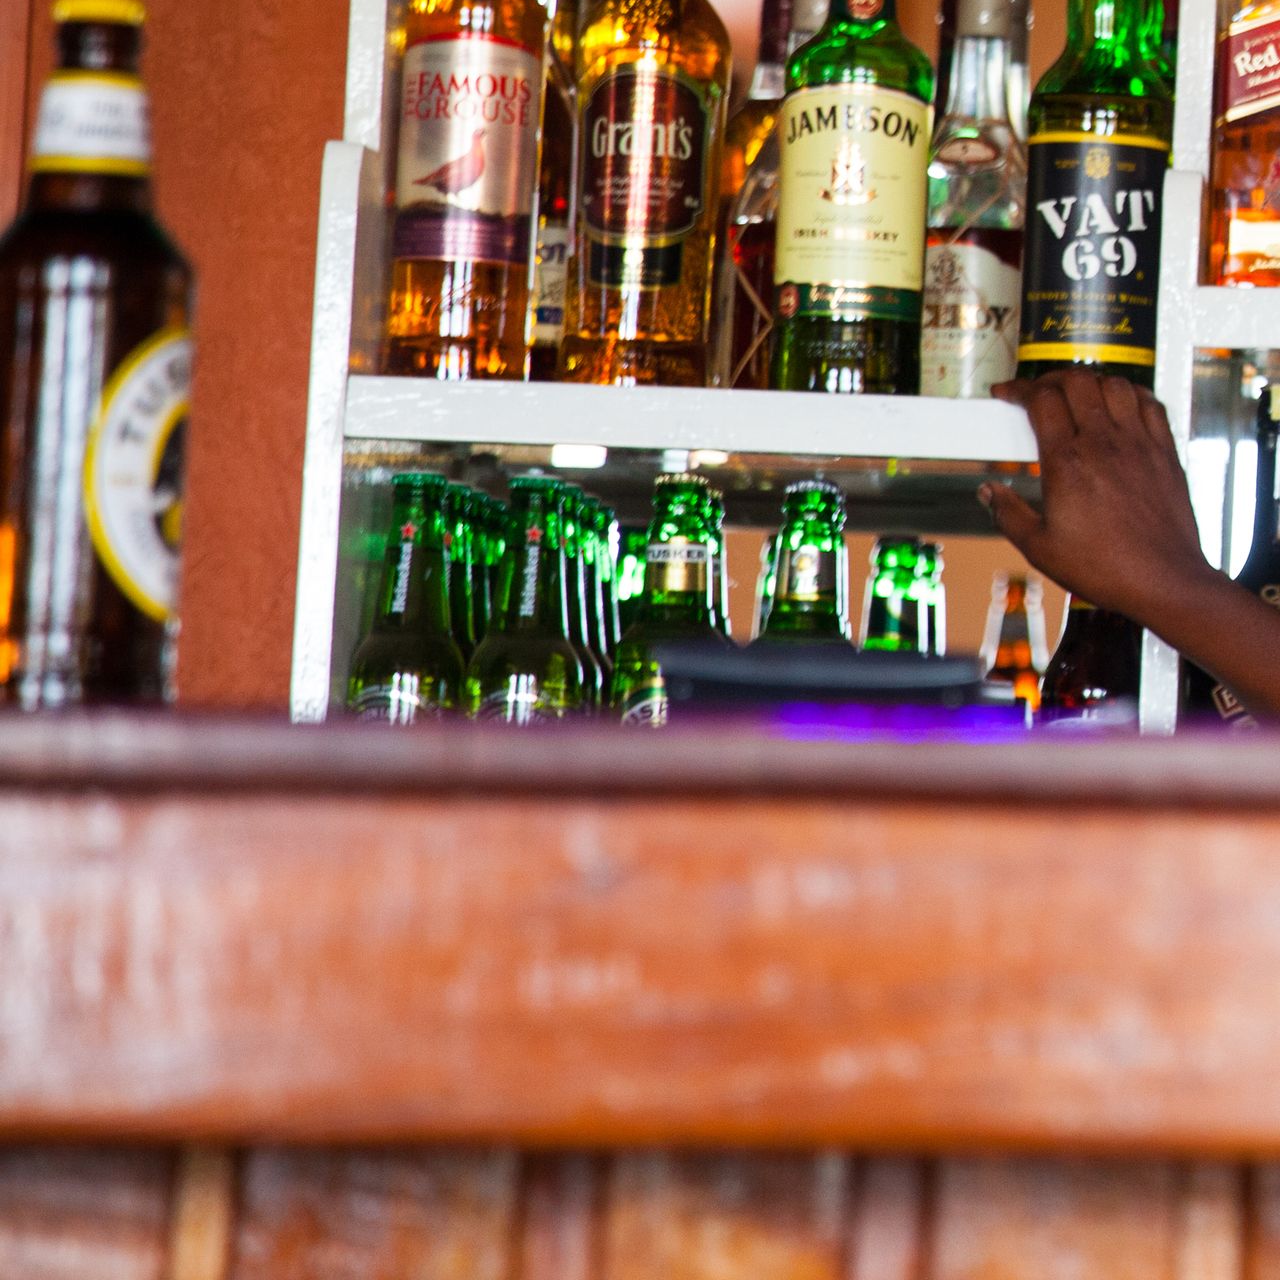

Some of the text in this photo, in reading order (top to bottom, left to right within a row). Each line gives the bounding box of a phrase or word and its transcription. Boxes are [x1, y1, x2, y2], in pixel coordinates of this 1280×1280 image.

[1233, 42, 1280, 78] Red
[418, 72, 532, 102] FAMOUS
[414, 96, 530, 127] GROUSE
[786, 102, 919, 148] JAMESON
[592, 114, 694, 161] Grant's
[1036, 189, 1155, 240] VAT
[1061, 235, 1138, 281] 69
